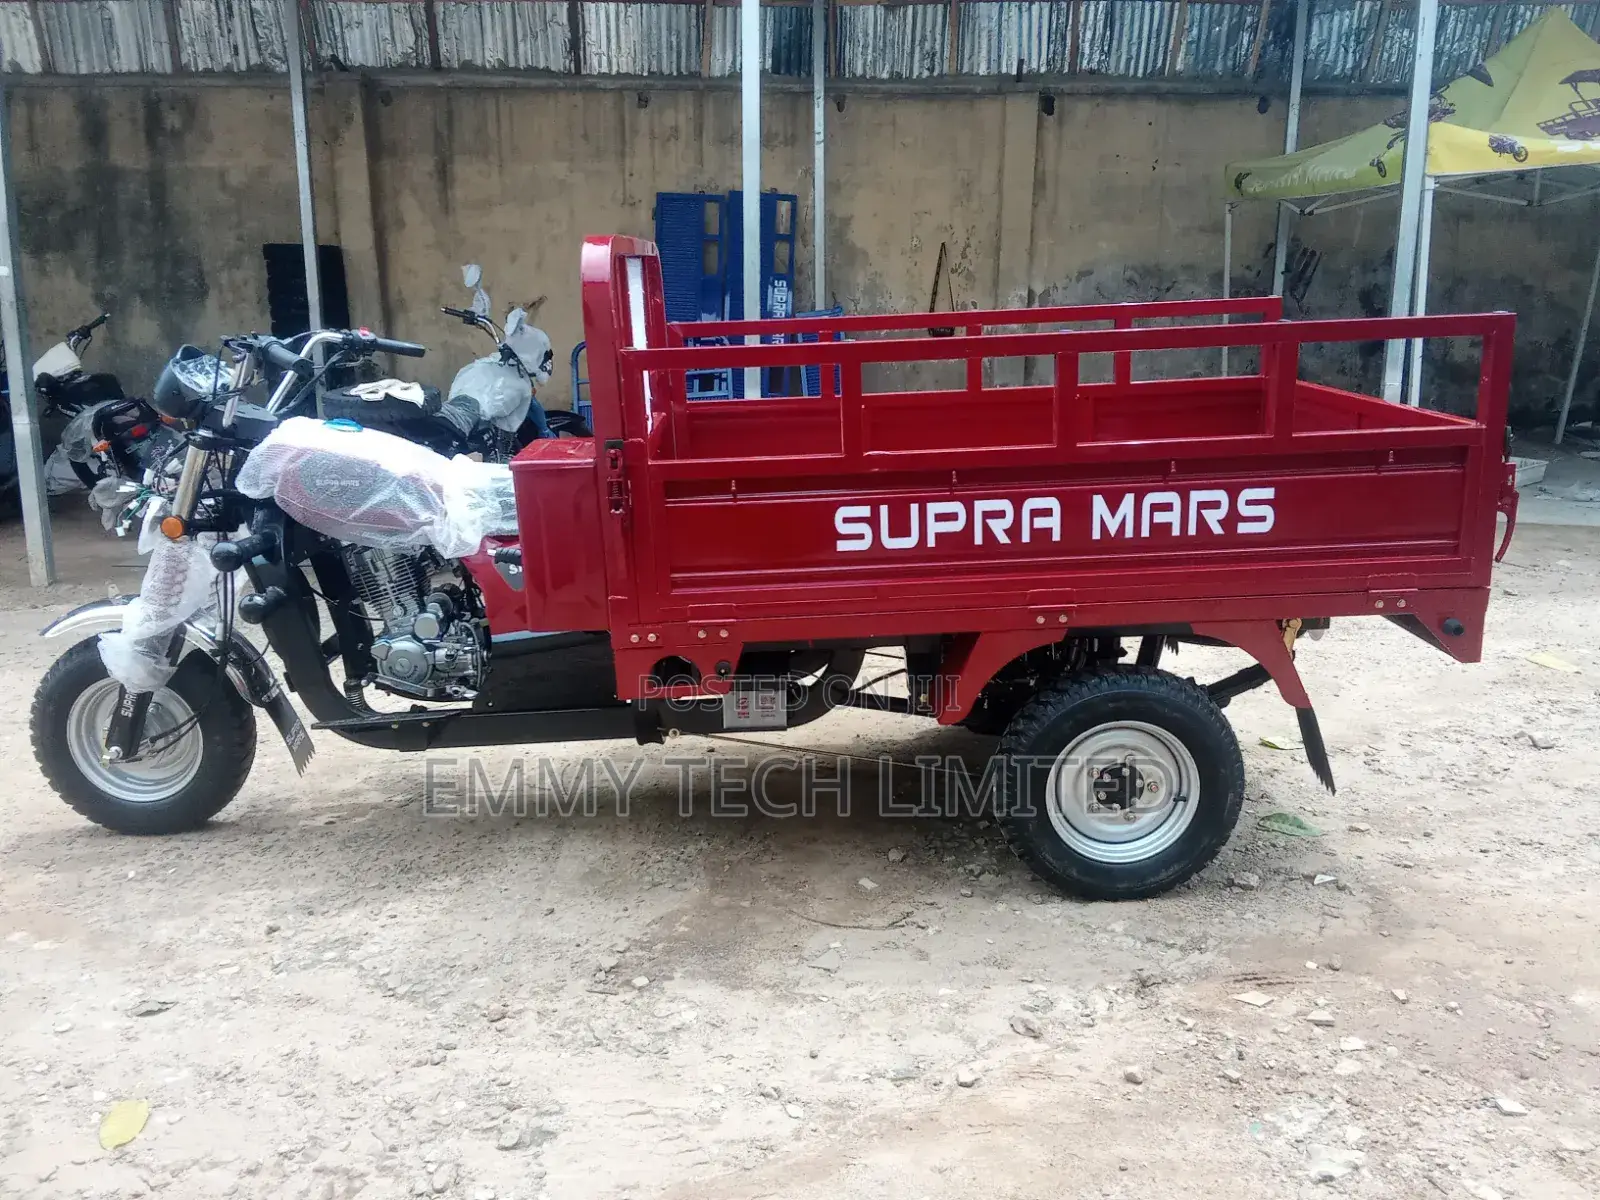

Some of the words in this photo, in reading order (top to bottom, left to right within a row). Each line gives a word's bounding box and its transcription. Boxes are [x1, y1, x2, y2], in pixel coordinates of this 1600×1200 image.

[773, 280, 787, 318] SUPRA
[834, 496, 1061, 552] SUPRA
[1092, 487, 1276, 540] MARS
